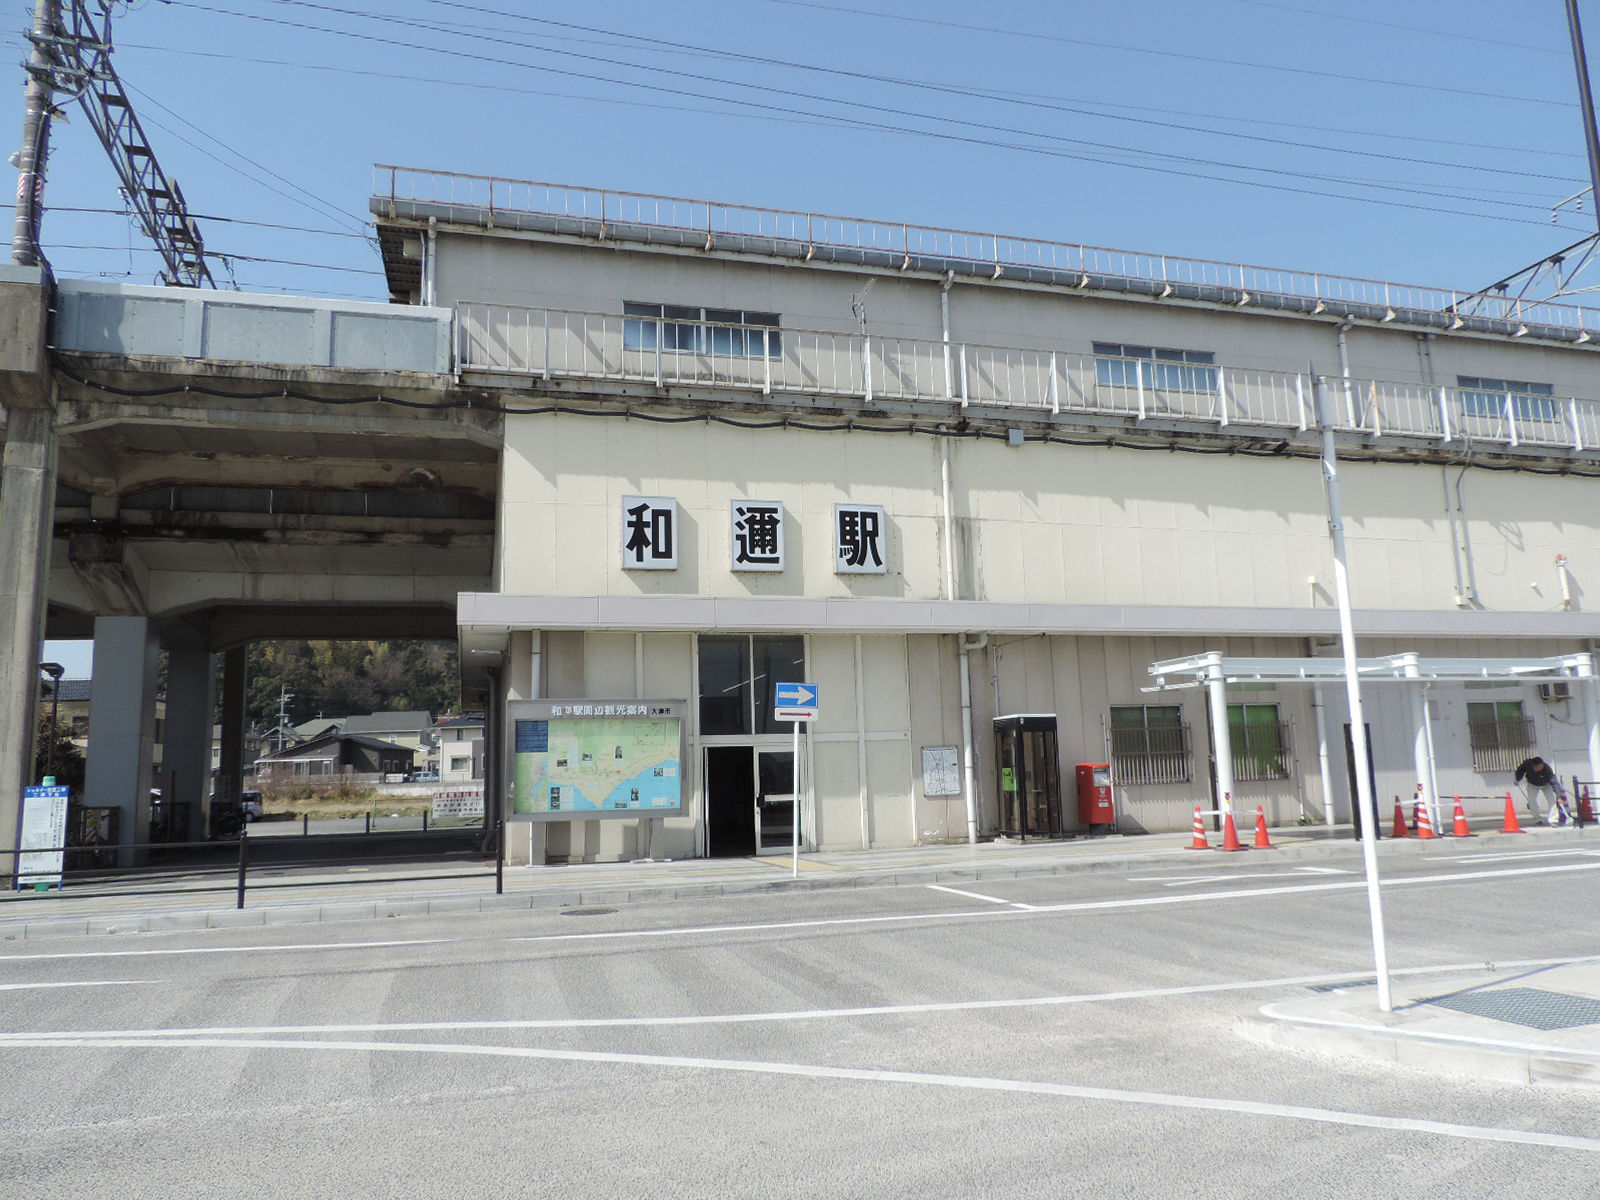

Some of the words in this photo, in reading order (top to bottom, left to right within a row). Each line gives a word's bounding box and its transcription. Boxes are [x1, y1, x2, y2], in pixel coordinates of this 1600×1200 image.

[625, 502, 883, 568] 和邇駅
[651, 707, 671, 715] 大津市
